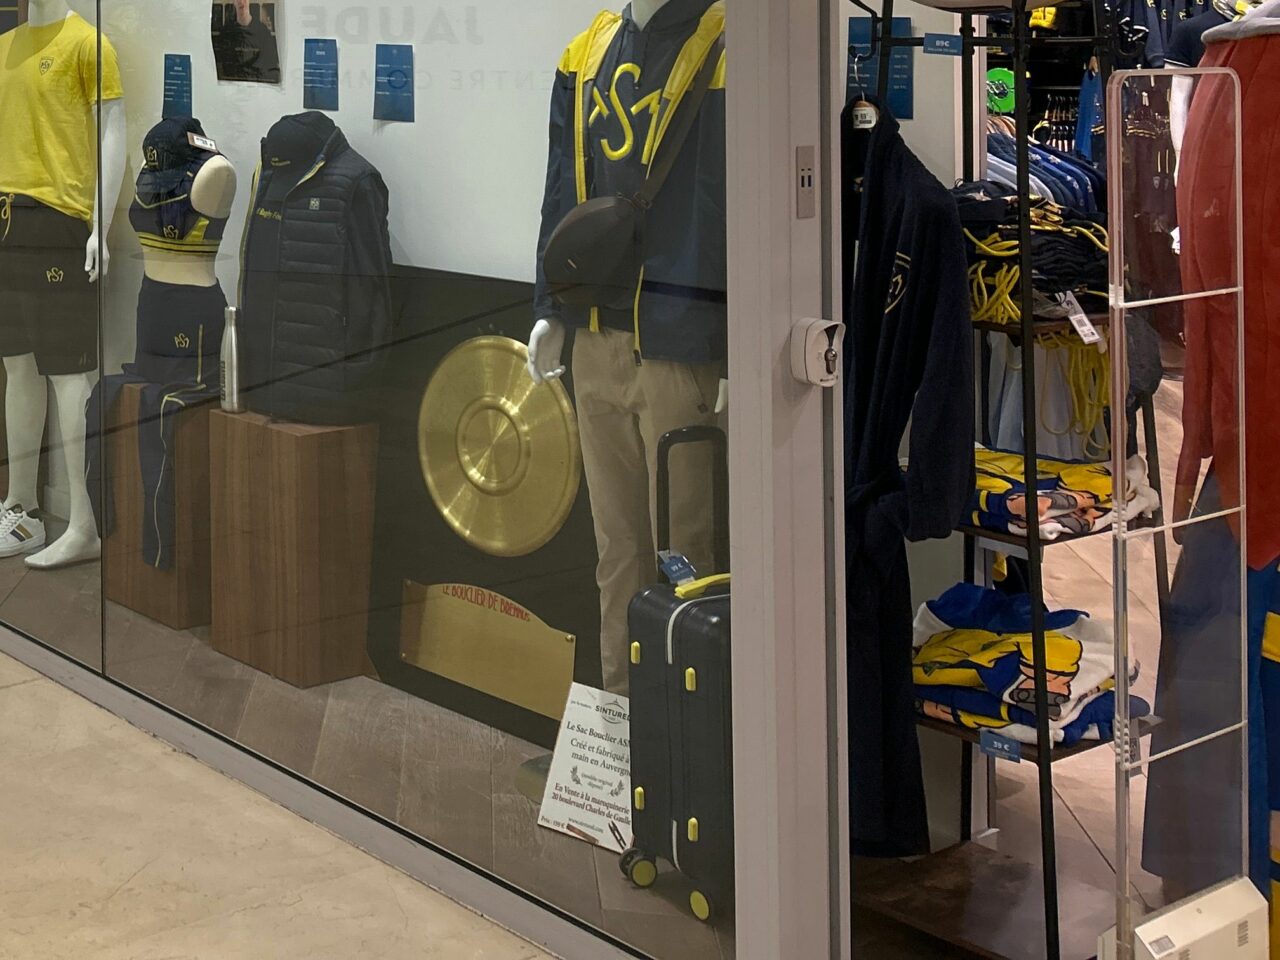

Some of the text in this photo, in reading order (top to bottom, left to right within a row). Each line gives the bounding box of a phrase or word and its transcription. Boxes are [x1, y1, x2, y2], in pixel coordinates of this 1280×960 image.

[442, 585, 531, 622] LE BOUCLIER DE BRENNUS
[567, 721, 575, 731] Le
[576, 724, 588, 734] Sac
[589, 728, 617, 744] Bouclier
[570, 738, 587, 750] Créé
[588, 745, 595, 753] et
[596, 745, 625, 762] fabriqué
[572, 752, 631, 777] main en Auvergn
[552, 792, 631, 825] 20 boulevard Charles de Gaulle
[555, 783, 563, 792] En
[564, 785, 580, 797] Vente
[591, 796, 630, 814] maroquinerie
